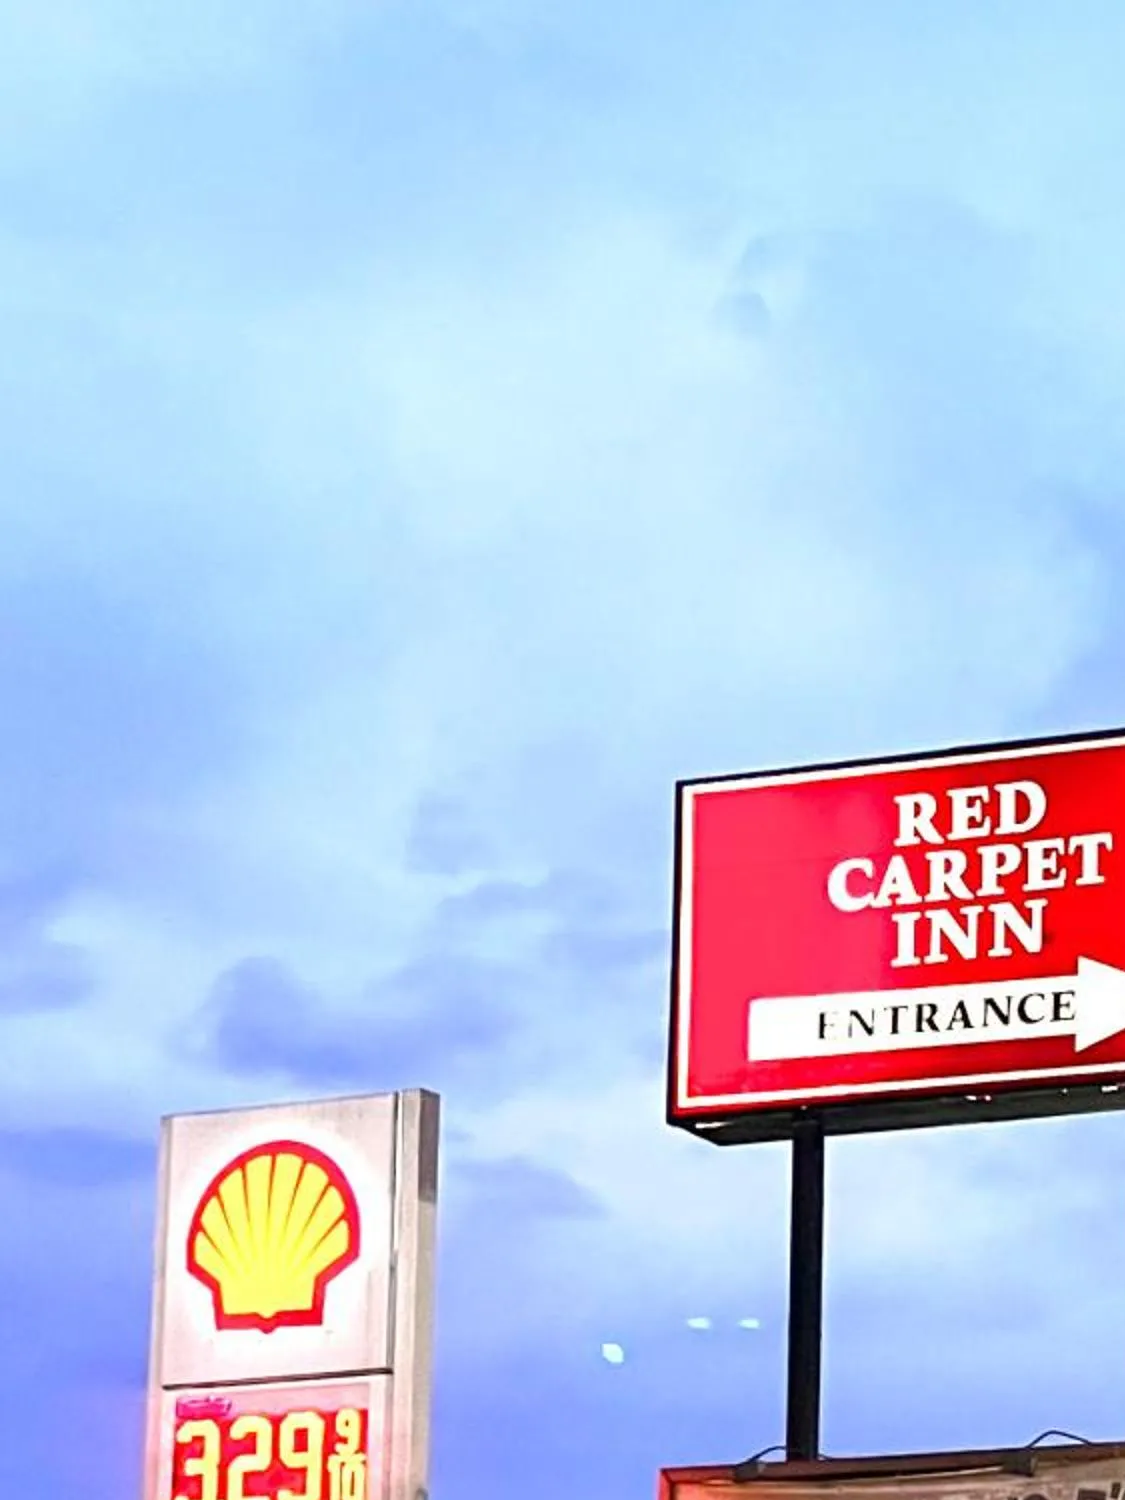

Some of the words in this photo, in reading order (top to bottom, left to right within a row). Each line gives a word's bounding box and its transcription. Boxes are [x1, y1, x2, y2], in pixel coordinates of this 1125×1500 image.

[893, 780, 1047, 847] RED
[826, 831, 1113, 913] CARPET
[890, 899, 1049, 968] INN
[818, 989, 1078, 1041] ENTRANCE
